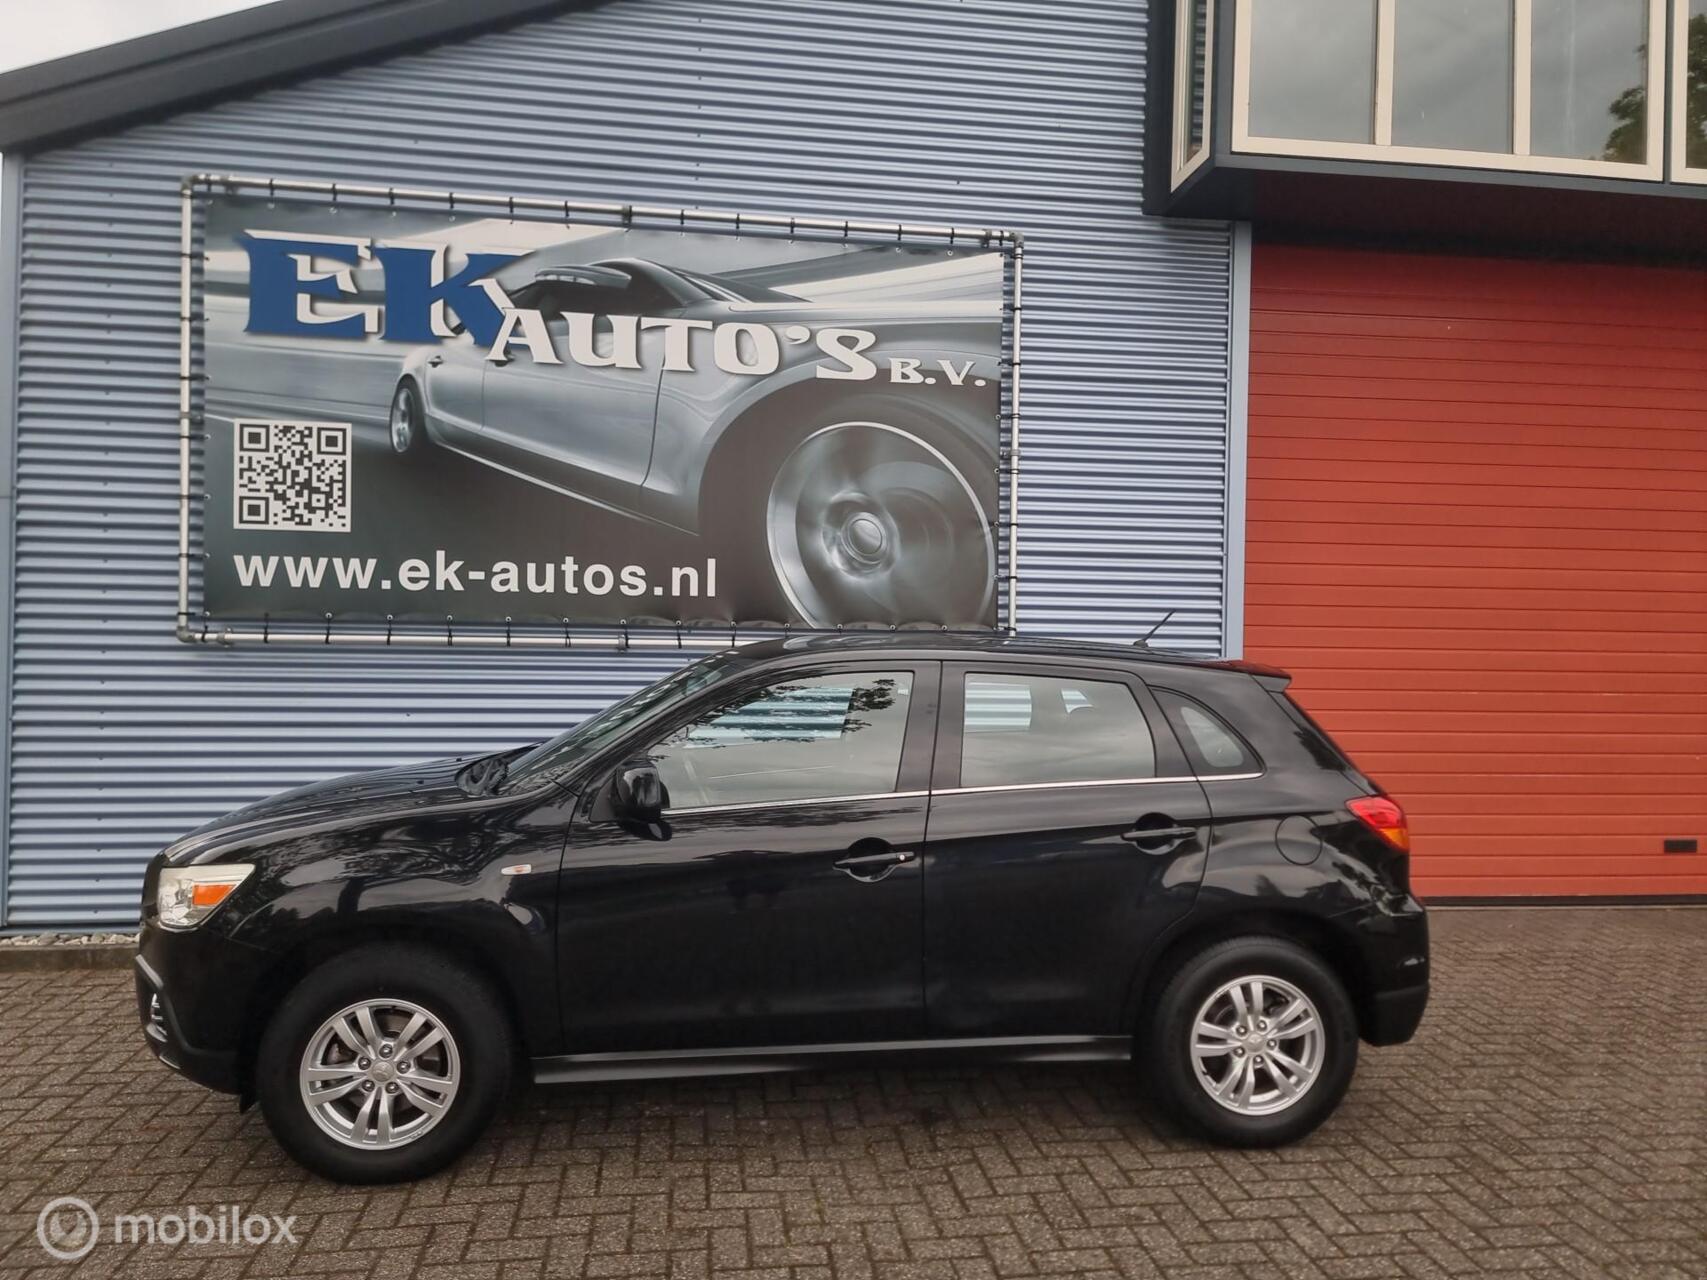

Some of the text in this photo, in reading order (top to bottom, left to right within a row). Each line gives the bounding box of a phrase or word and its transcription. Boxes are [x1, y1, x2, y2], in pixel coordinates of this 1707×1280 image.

[234, 229, 535, 348] EK
[888, 356, 987, 387] B.V.
[233, 549, 717, 598] www.ek-autos.nl
